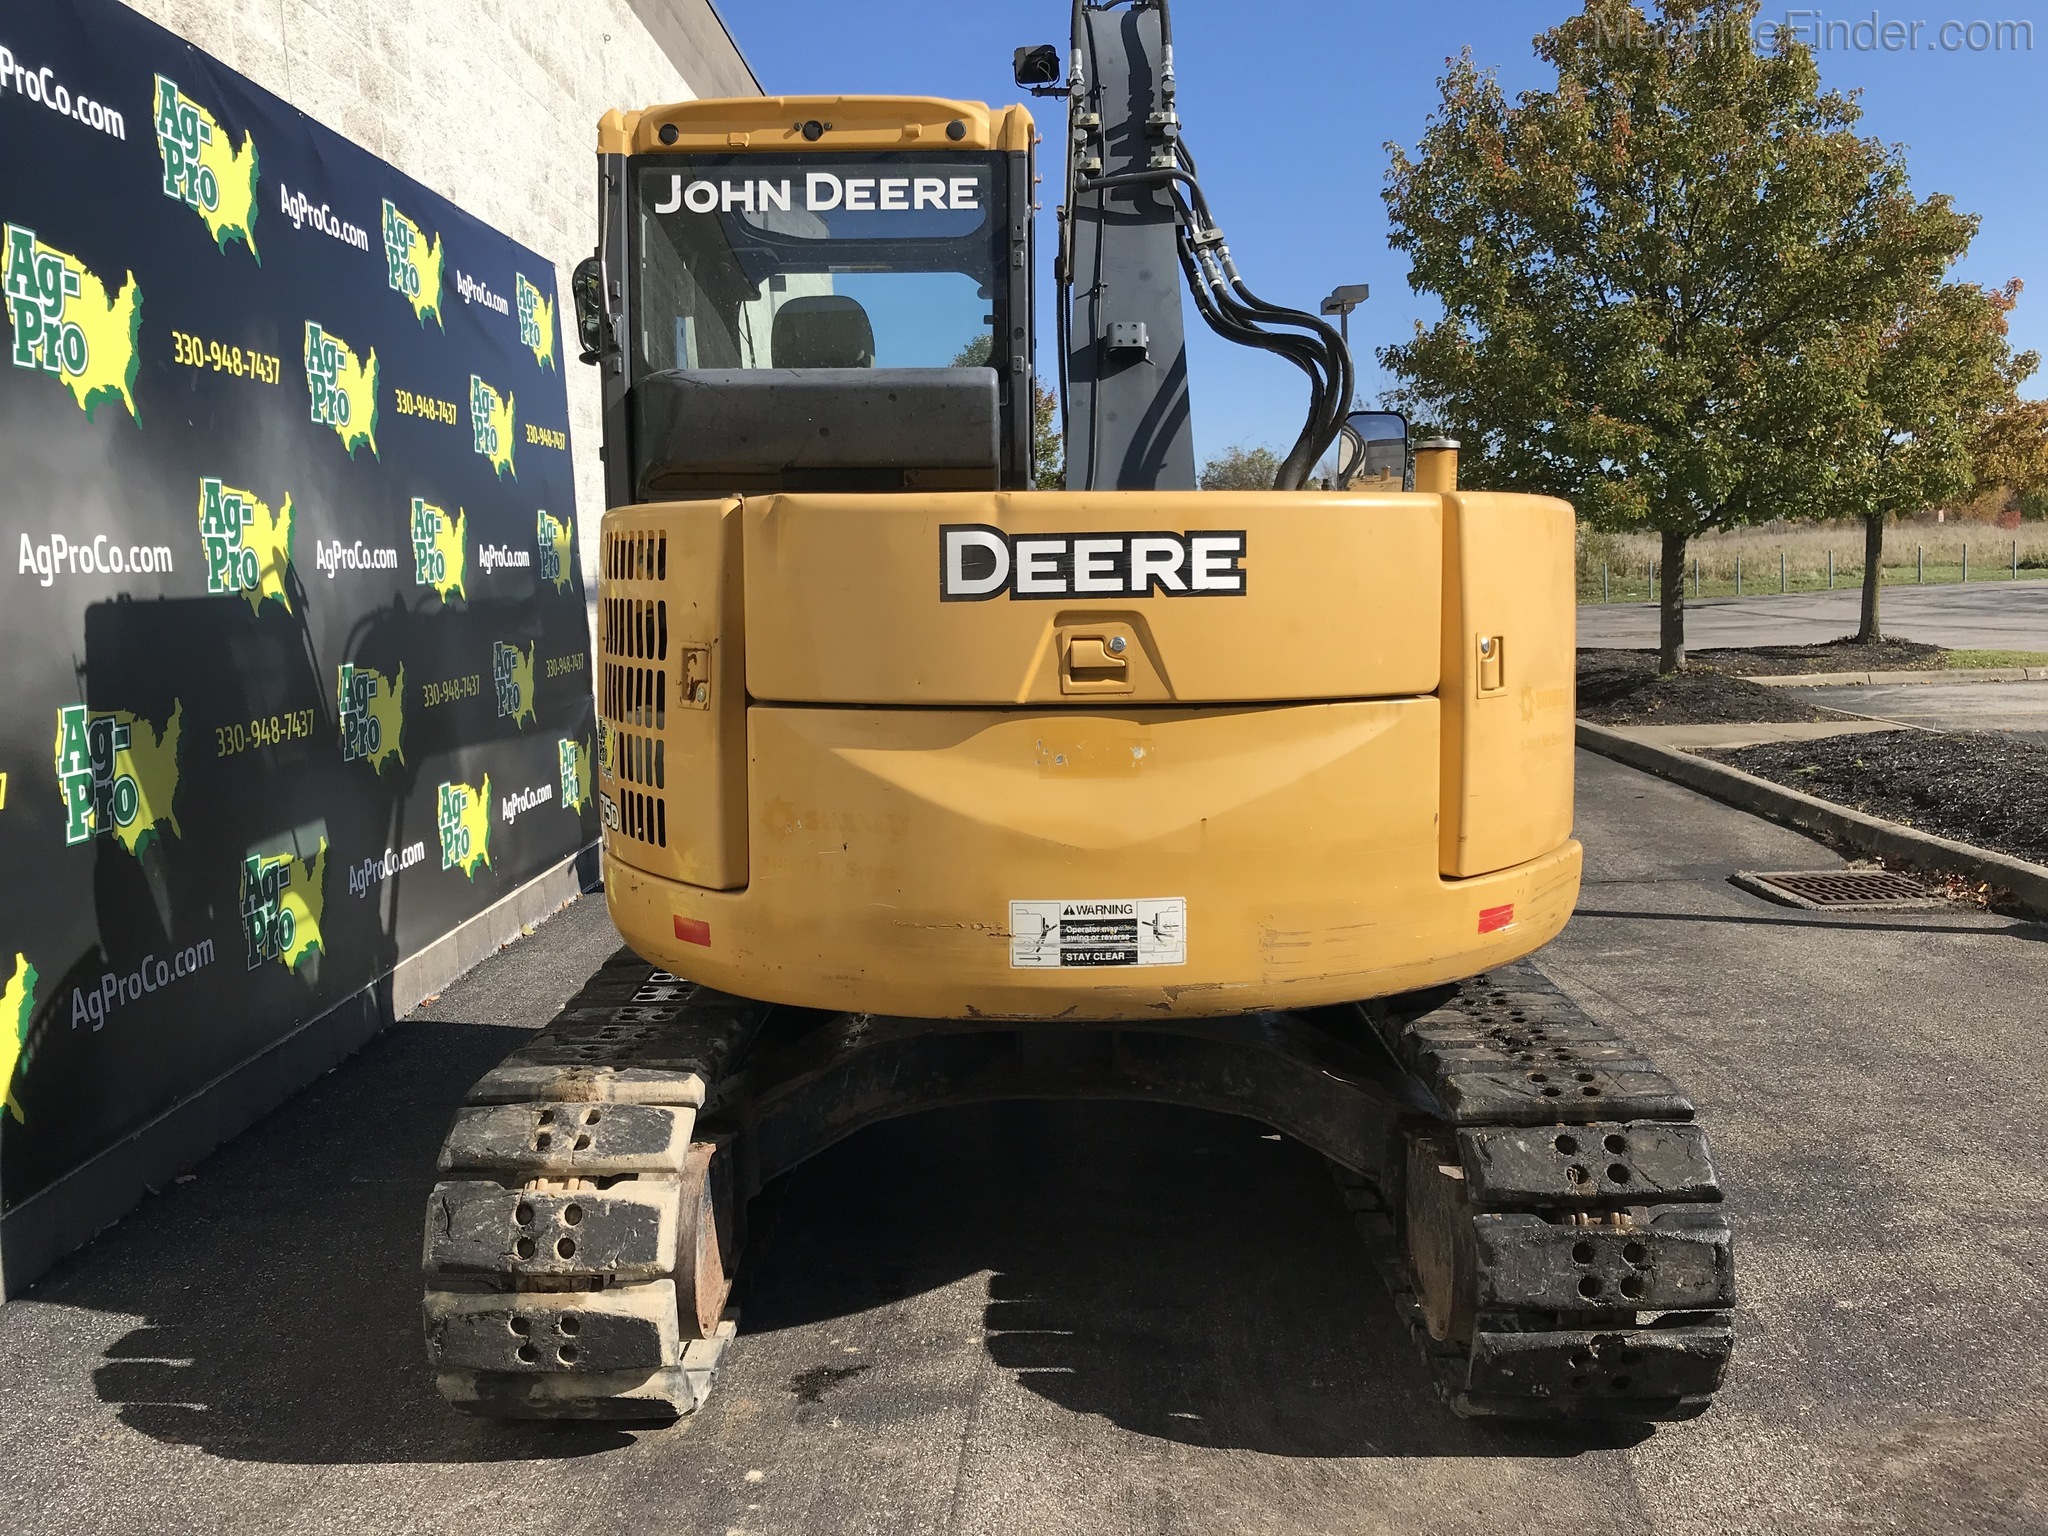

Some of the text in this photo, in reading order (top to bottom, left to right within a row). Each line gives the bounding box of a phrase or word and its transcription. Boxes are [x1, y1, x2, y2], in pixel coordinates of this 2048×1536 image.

[0, 44, 126, 141] ProCo.com
[156, 75, 212, 160] Ag-
[161, 141, 219, 212] Pro
[655, 172, 979, 213] JOHN DEERE
[280, 183, 369, 252] AgProCo.com
[384, 199, 416, 260] Ag-
[5, 225, 81, 321] Ag-
[388, 248, 421, 298] Pro
[456, 269, 509, 316] AgProCo.com
[11, 297, 89, 376] Pro
[306, 322, 346, 386] Ag-
[520, 311, 541, 349] Pro
[171, 331, 280, 385] 330-948-7437
[310, 372, 351, 427] Pro
[395, 389, 457, 426] 330-948-7437
[473, 416, 499, 454] Pro
[525, 423, 566, 451] 330-948-7437
[201, 478, 254, 548] Ag-
[412, 498, 442, 548] Ag-
[18, 532, 173, 588] AgProCo.com
[206, 535, 261, 593] Pro
[316, 539, 398, 579] AgProCo.com
[414, 541, 446, 585] Pro
[479, 543, 530, 575] AgProCo.com
[539, 544, 561, 579] Pro
[946, 528, 1242, 596] DEERE
[339, 664, 377, 720] Ag-
[422, 674, 480, 708] 330-948-7437
[497, 679, 522, 717] Pro
[59, 704, 131, 783] Ag-
[215, 708, 314, 757] 330-948-7437
[342, 712, 381, 762] Pro
[63, 768, 139, 845] Pro
[438, 781, 468, 833] Ag-
[502, 783, 553, 825] AgProCo.com
[561, 770, 581, 809] Pro
[349, 841, 426, 899] AgProCo.com
[441, 825, 470, 871] Pro
[242, 854, 291, 915] Ag-
[1076, 903, 1133, 916] WARNING
[245, 904, 296, 972] Pro
[1066, 951, 1126, 961] STAY CLEAR
[71, 938, 215, 1032] AgProCo.com
